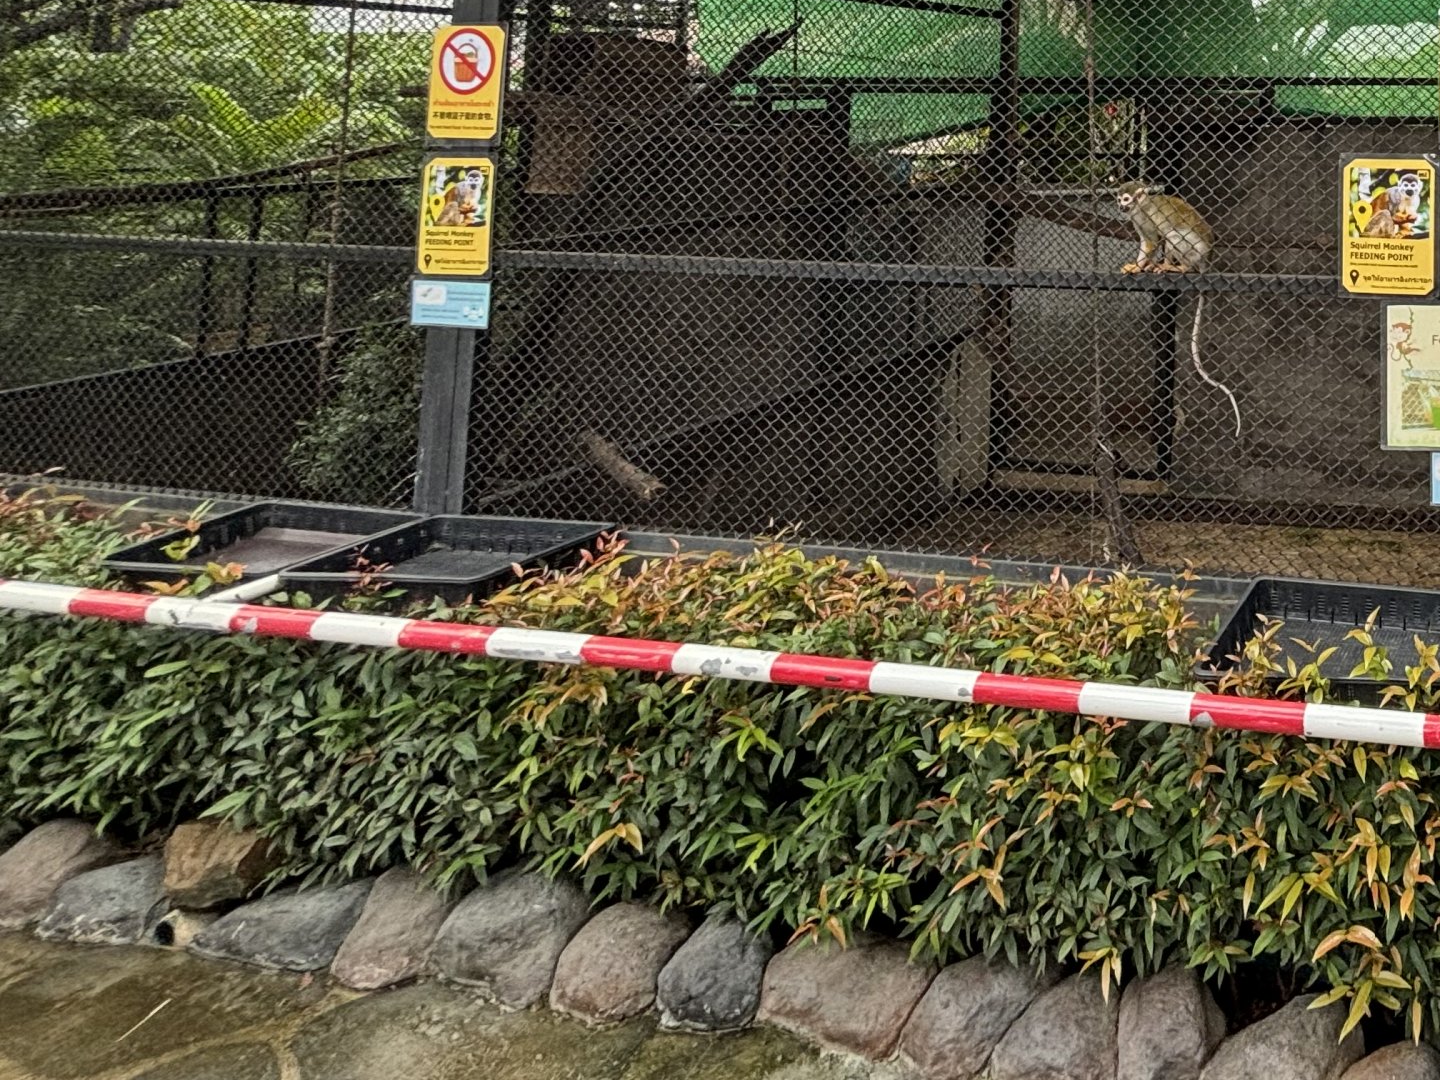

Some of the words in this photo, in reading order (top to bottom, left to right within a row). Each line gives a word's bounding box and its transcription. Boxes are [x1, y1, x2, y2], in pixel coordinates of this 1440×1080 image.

[425, 238, 453, 246] FEEDING
[1350, 241, 1381, 251] Squirrel
[1383, 242, 1414, 252] Monkey
[1350, 251, 1385, 260] FEEDING
[1387, 252, 1414, 261] POINT
